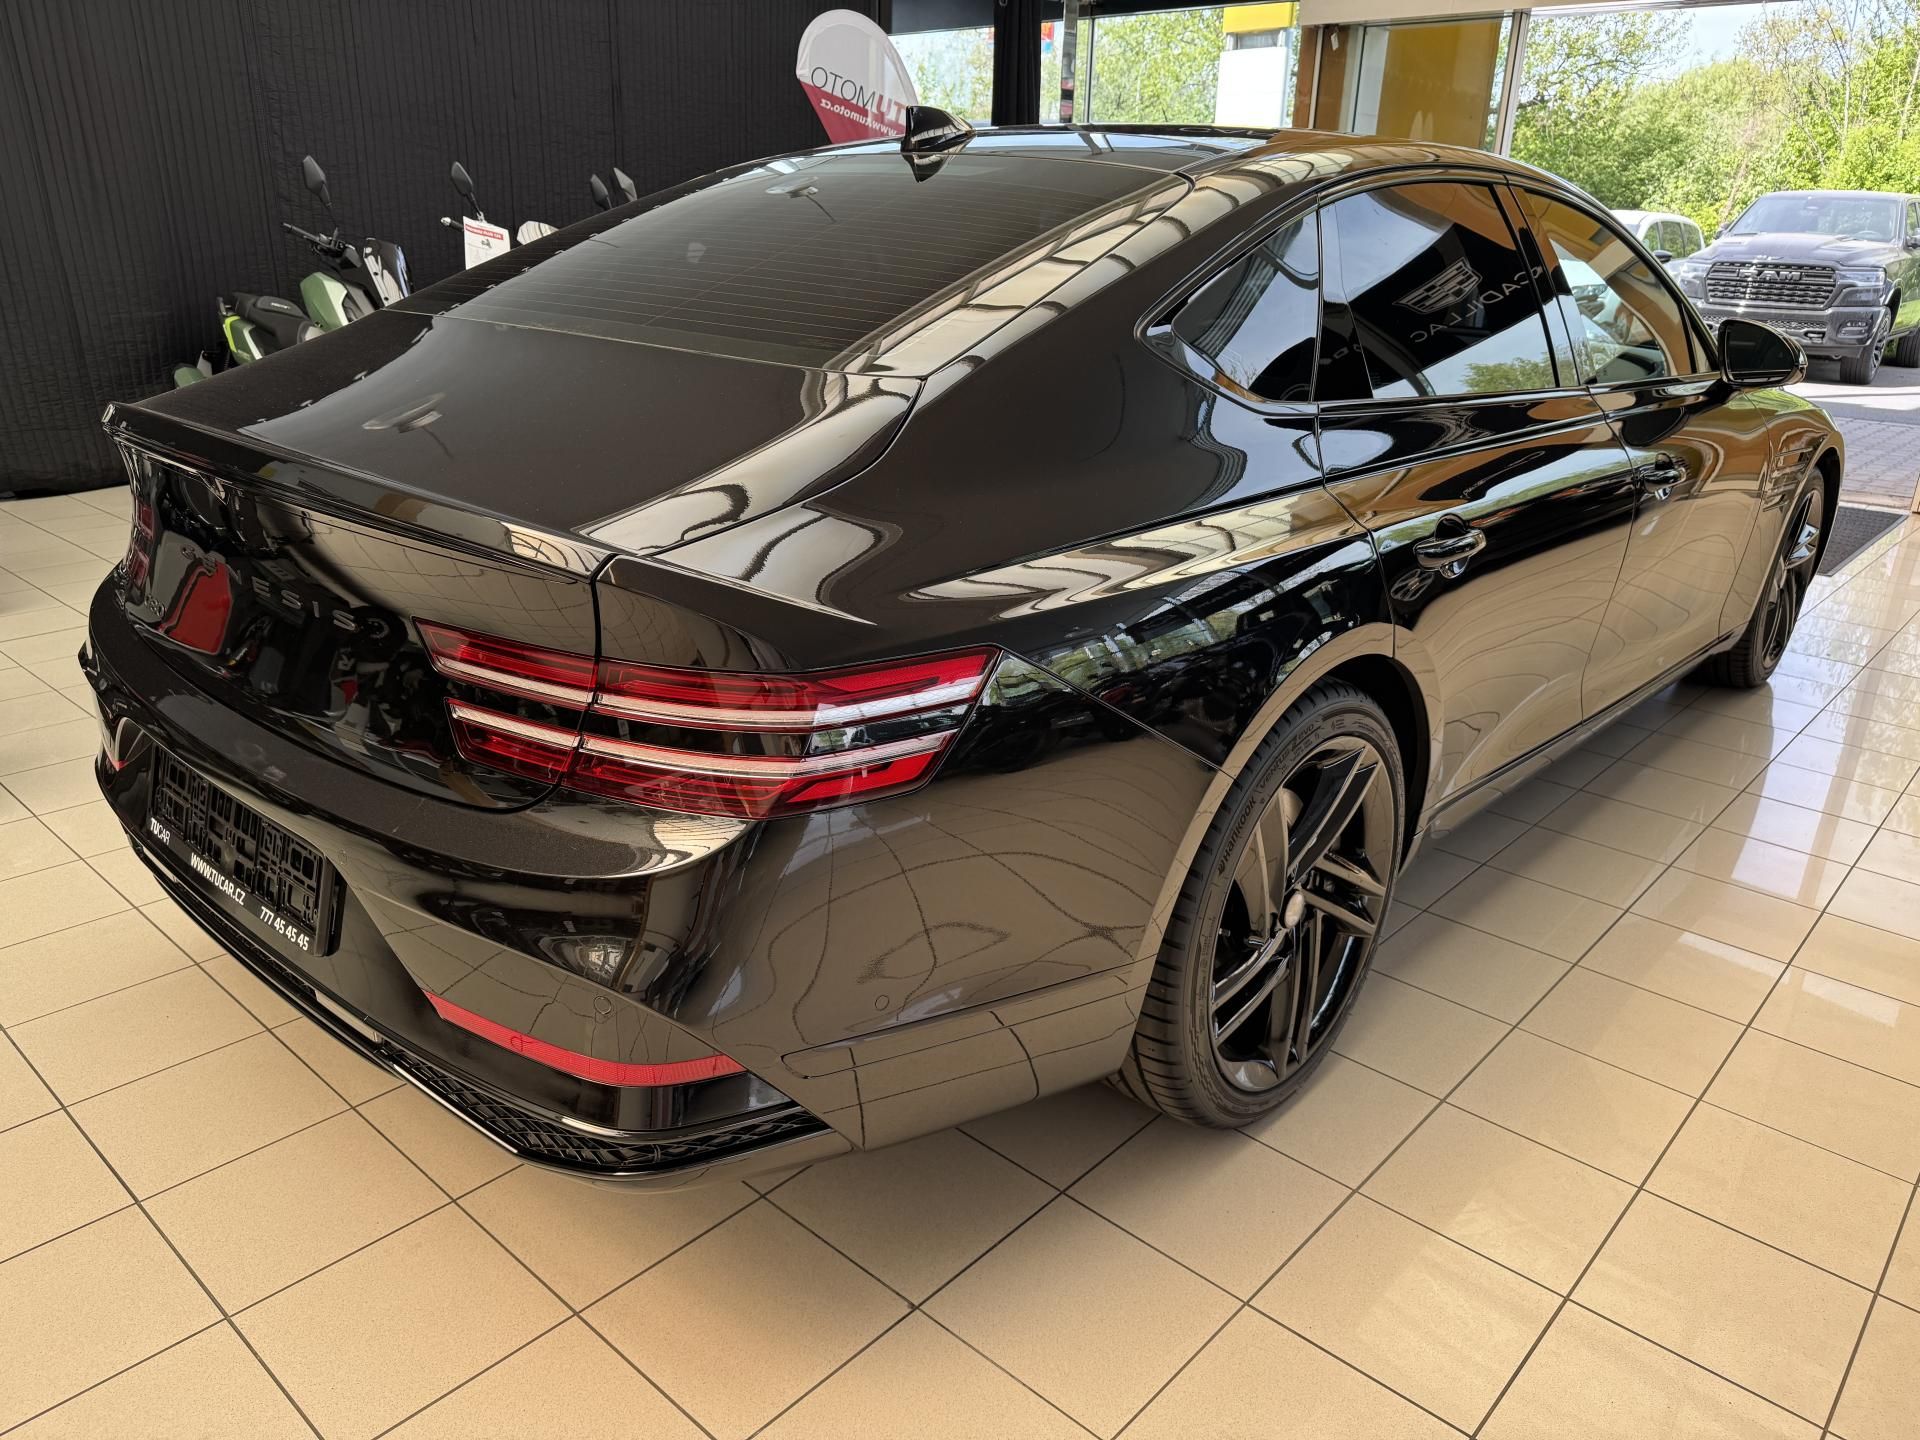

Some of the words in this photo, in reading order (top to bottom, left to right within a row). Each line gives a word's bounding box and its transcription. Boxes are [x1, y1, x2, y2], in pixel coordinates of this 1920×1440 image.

[1739, 269, 1801, 281] RAM
[181, 544, 357, 631] GENESIS
[150, 817, 171, 846] TUCAR
[190, 852, 246, 906] WWW.TUCAR.CZ
[260, 905, 274, 925] 777
[273, 917, 285, 934] 45
[285, 925, 297, 943] 45
[297, 934, 310, 951] 45
